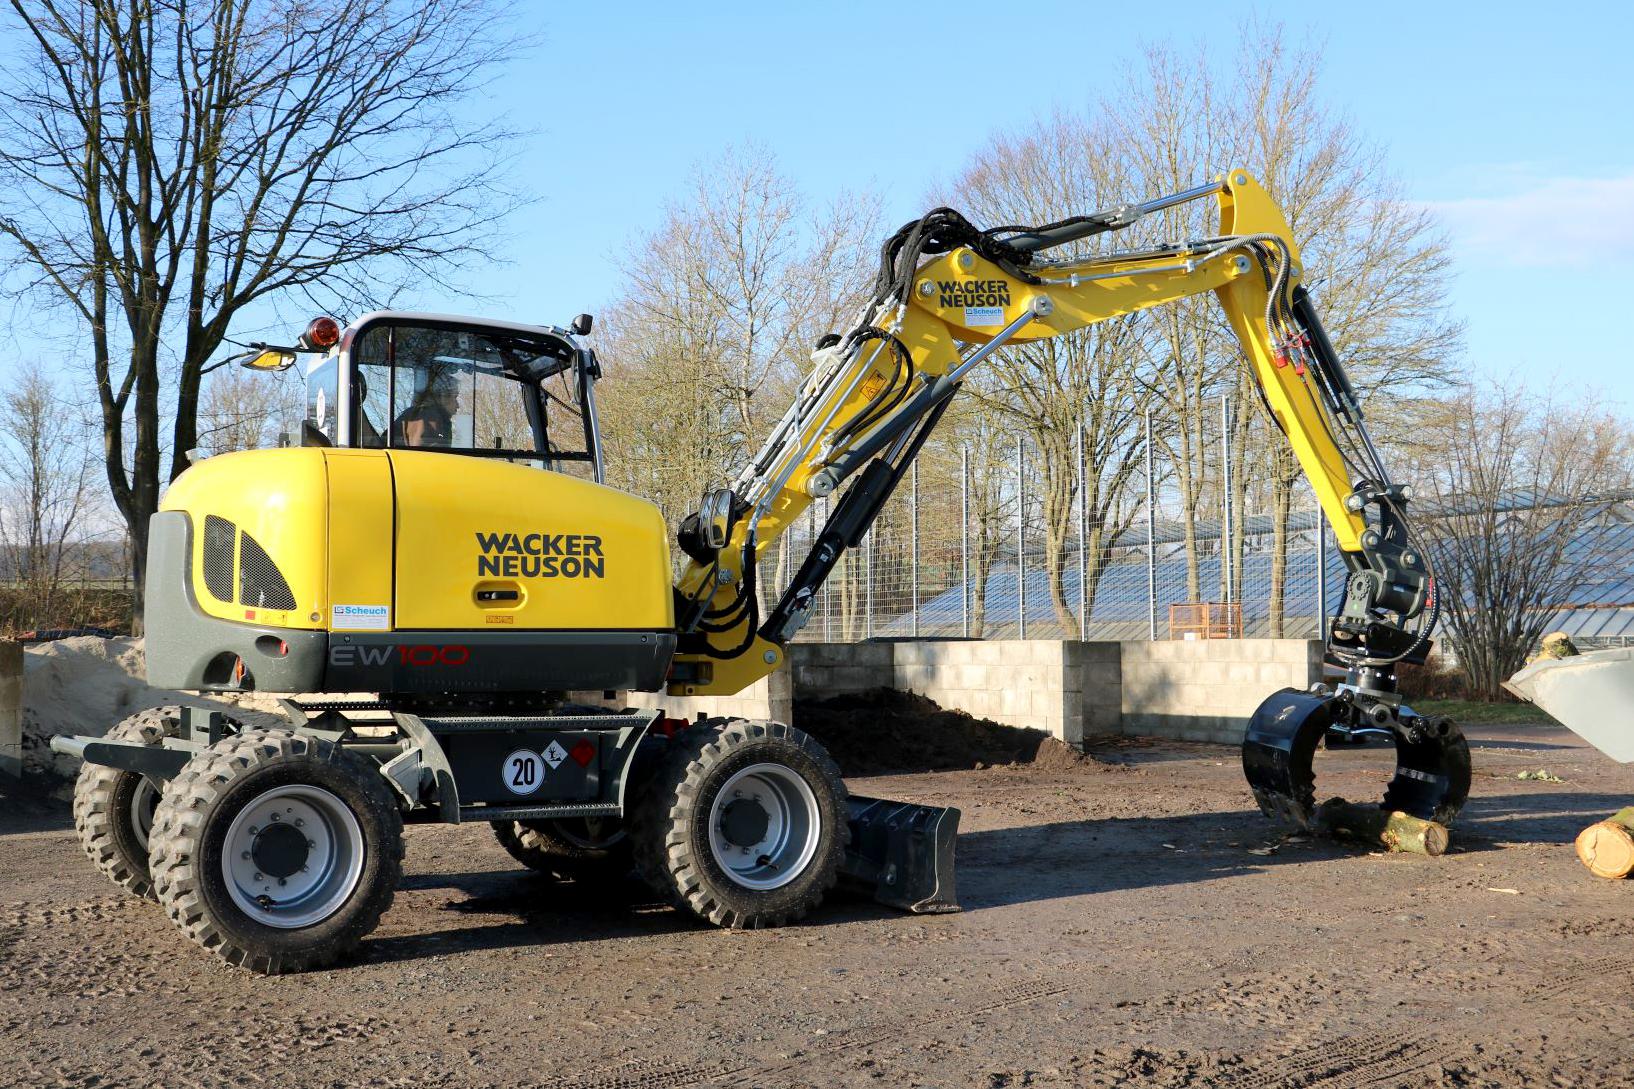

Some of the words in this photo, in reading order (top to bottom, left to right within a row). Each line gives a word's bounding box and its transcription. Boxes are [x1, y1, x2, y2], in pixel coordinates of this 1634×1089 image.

[937, 281, 1010, 294] WACKER
[940, 293, 1011, 308] NEUSON
[475, 532, 604, 556] WACKER
[478, 555, 605, 578] NEUSON
[345, 606, 387, 615] Scheuch
[512, 758, 535, 786] 20
